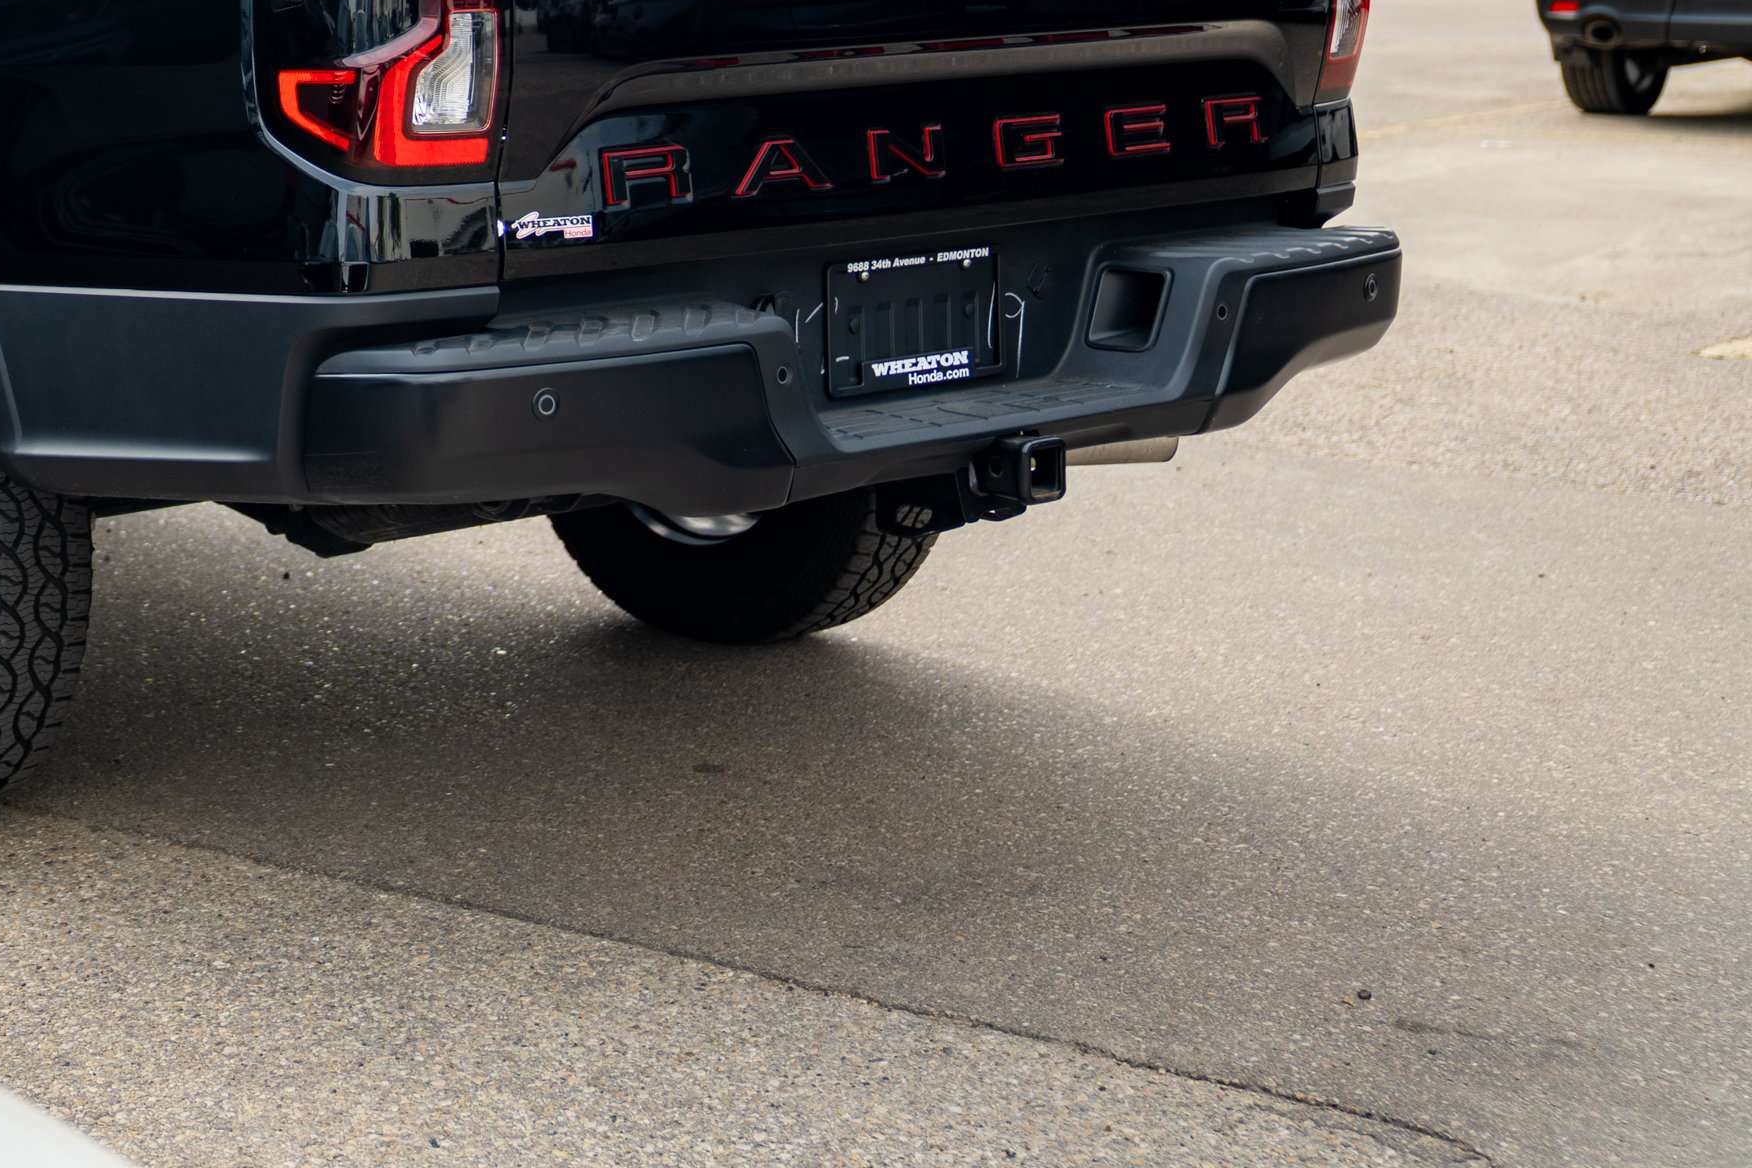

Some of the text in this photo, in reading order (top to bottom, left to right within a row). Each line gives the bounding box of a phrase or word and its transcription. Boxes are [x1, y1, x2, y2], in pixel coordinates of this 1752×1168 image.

[601, 94, 1270, 209] RANGER
[517, 217, 591, 229] WHEATON
[847, 260, 870, 273] 9688
[871, 258, 891, 271] 34th
[892, 256, 926, 268] Avenue
[936, 247, 989, 263] EDMONTON
[871, 350, 969, 377] WHEATON
[908, 367, 970, 385] Honda.com
